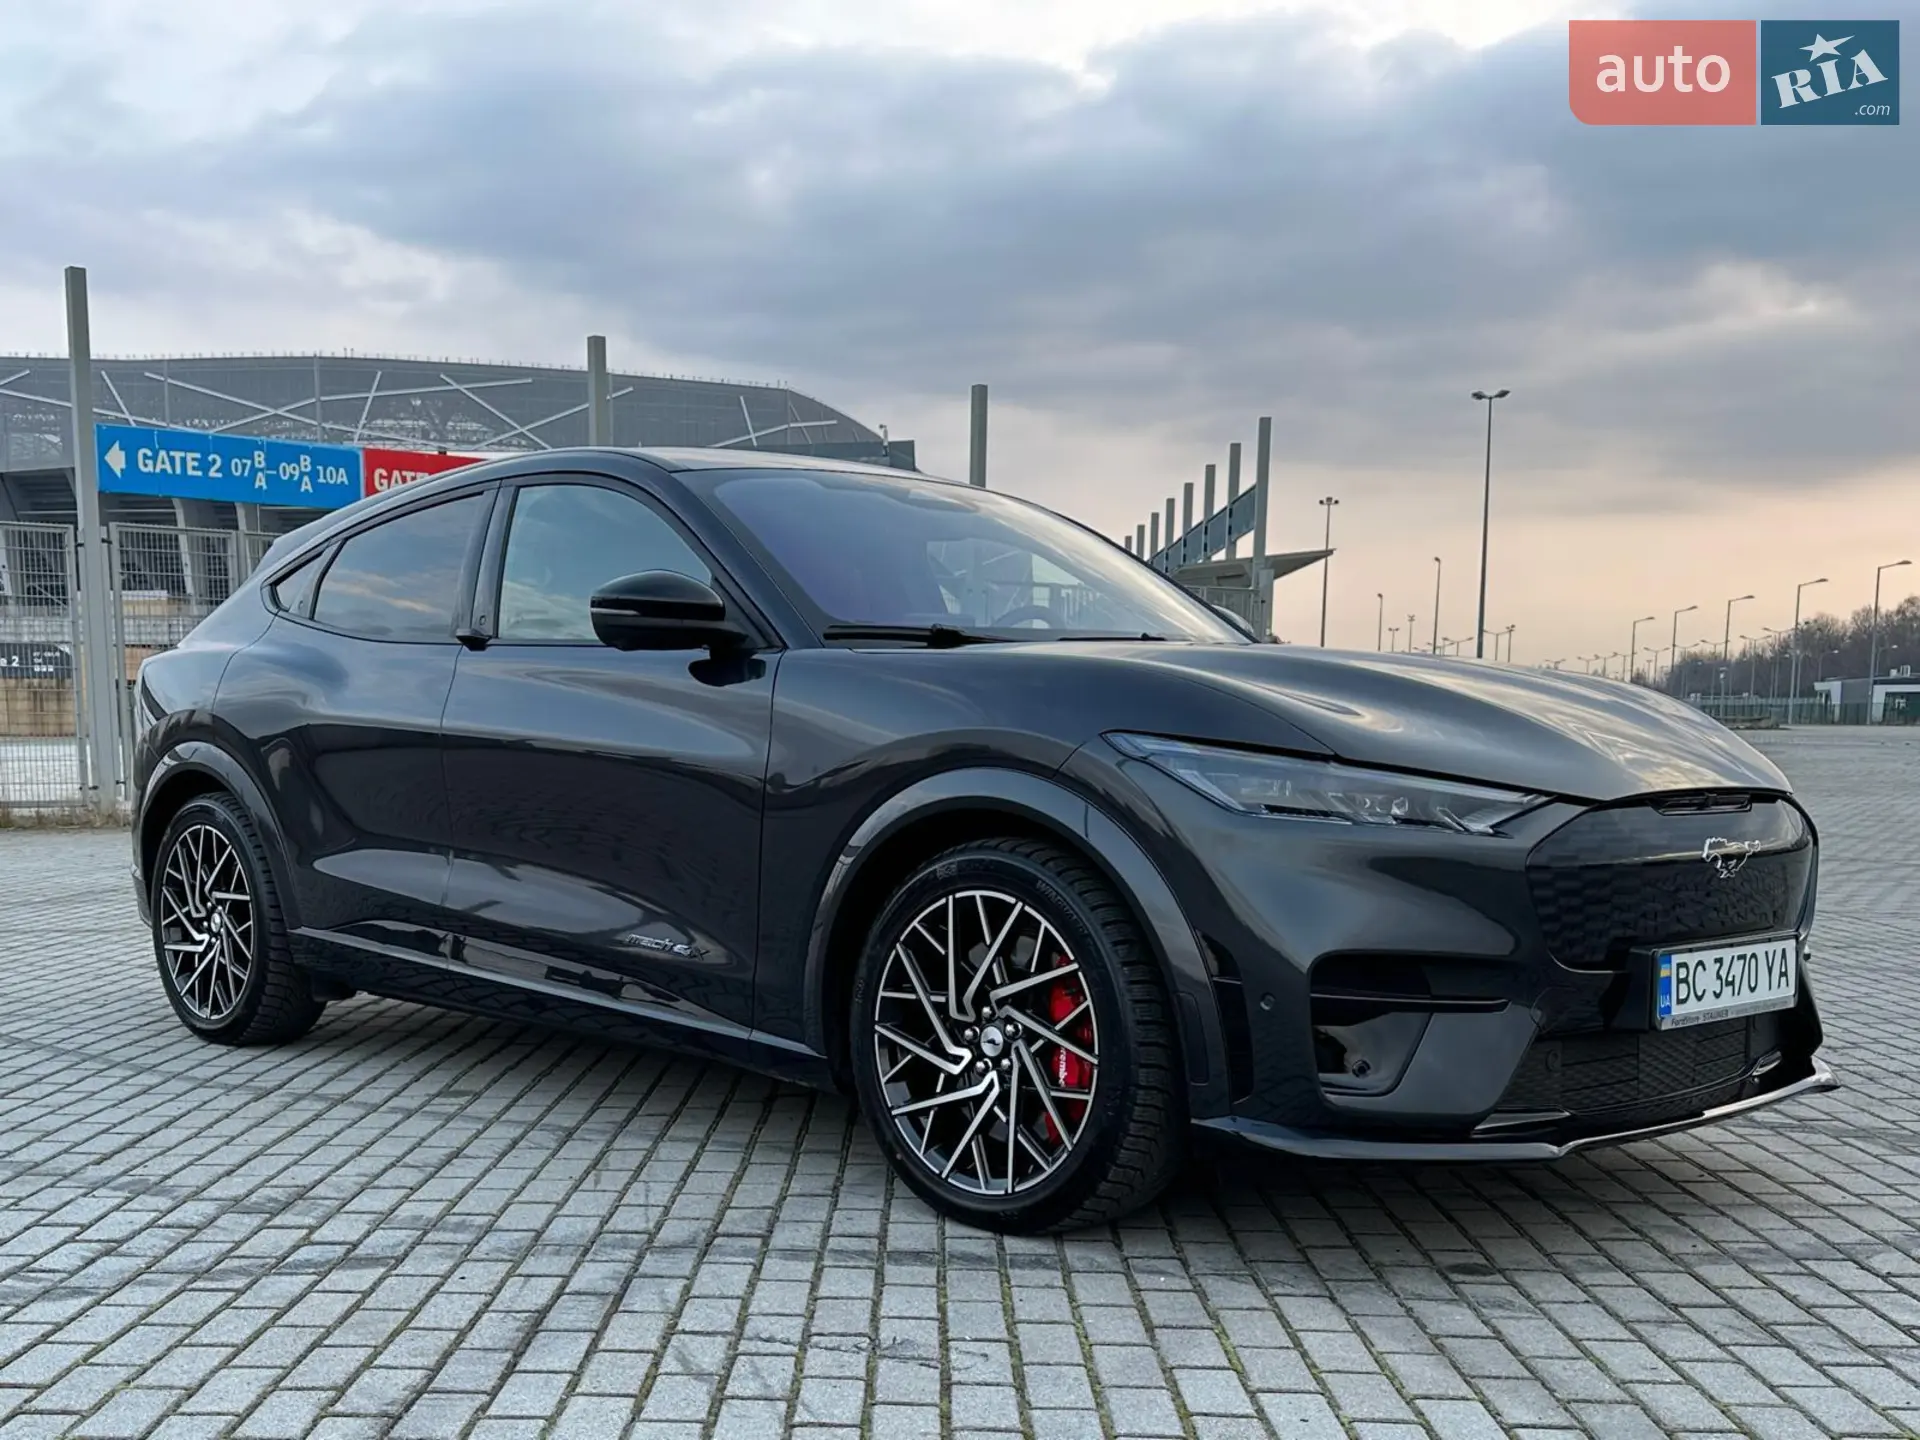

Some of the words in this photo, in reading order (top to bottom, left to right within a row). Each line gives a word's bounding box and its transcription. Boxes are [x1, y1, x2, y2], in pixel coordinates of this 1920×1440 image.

[137, 448, 201, 476] GATE
[208, 455, 222, 478] 2
[231, 458, 252, 477] 07
[316, 466, 349, 485] 10A
[374, 467, 430, 492] GAT
[1675, 959, 1706, 1006] BC
[1712, 952, 1758, 1000] 3470
[1765, 947, 1789, 991] YA
[1660, 994, 1671, 1008] UA
